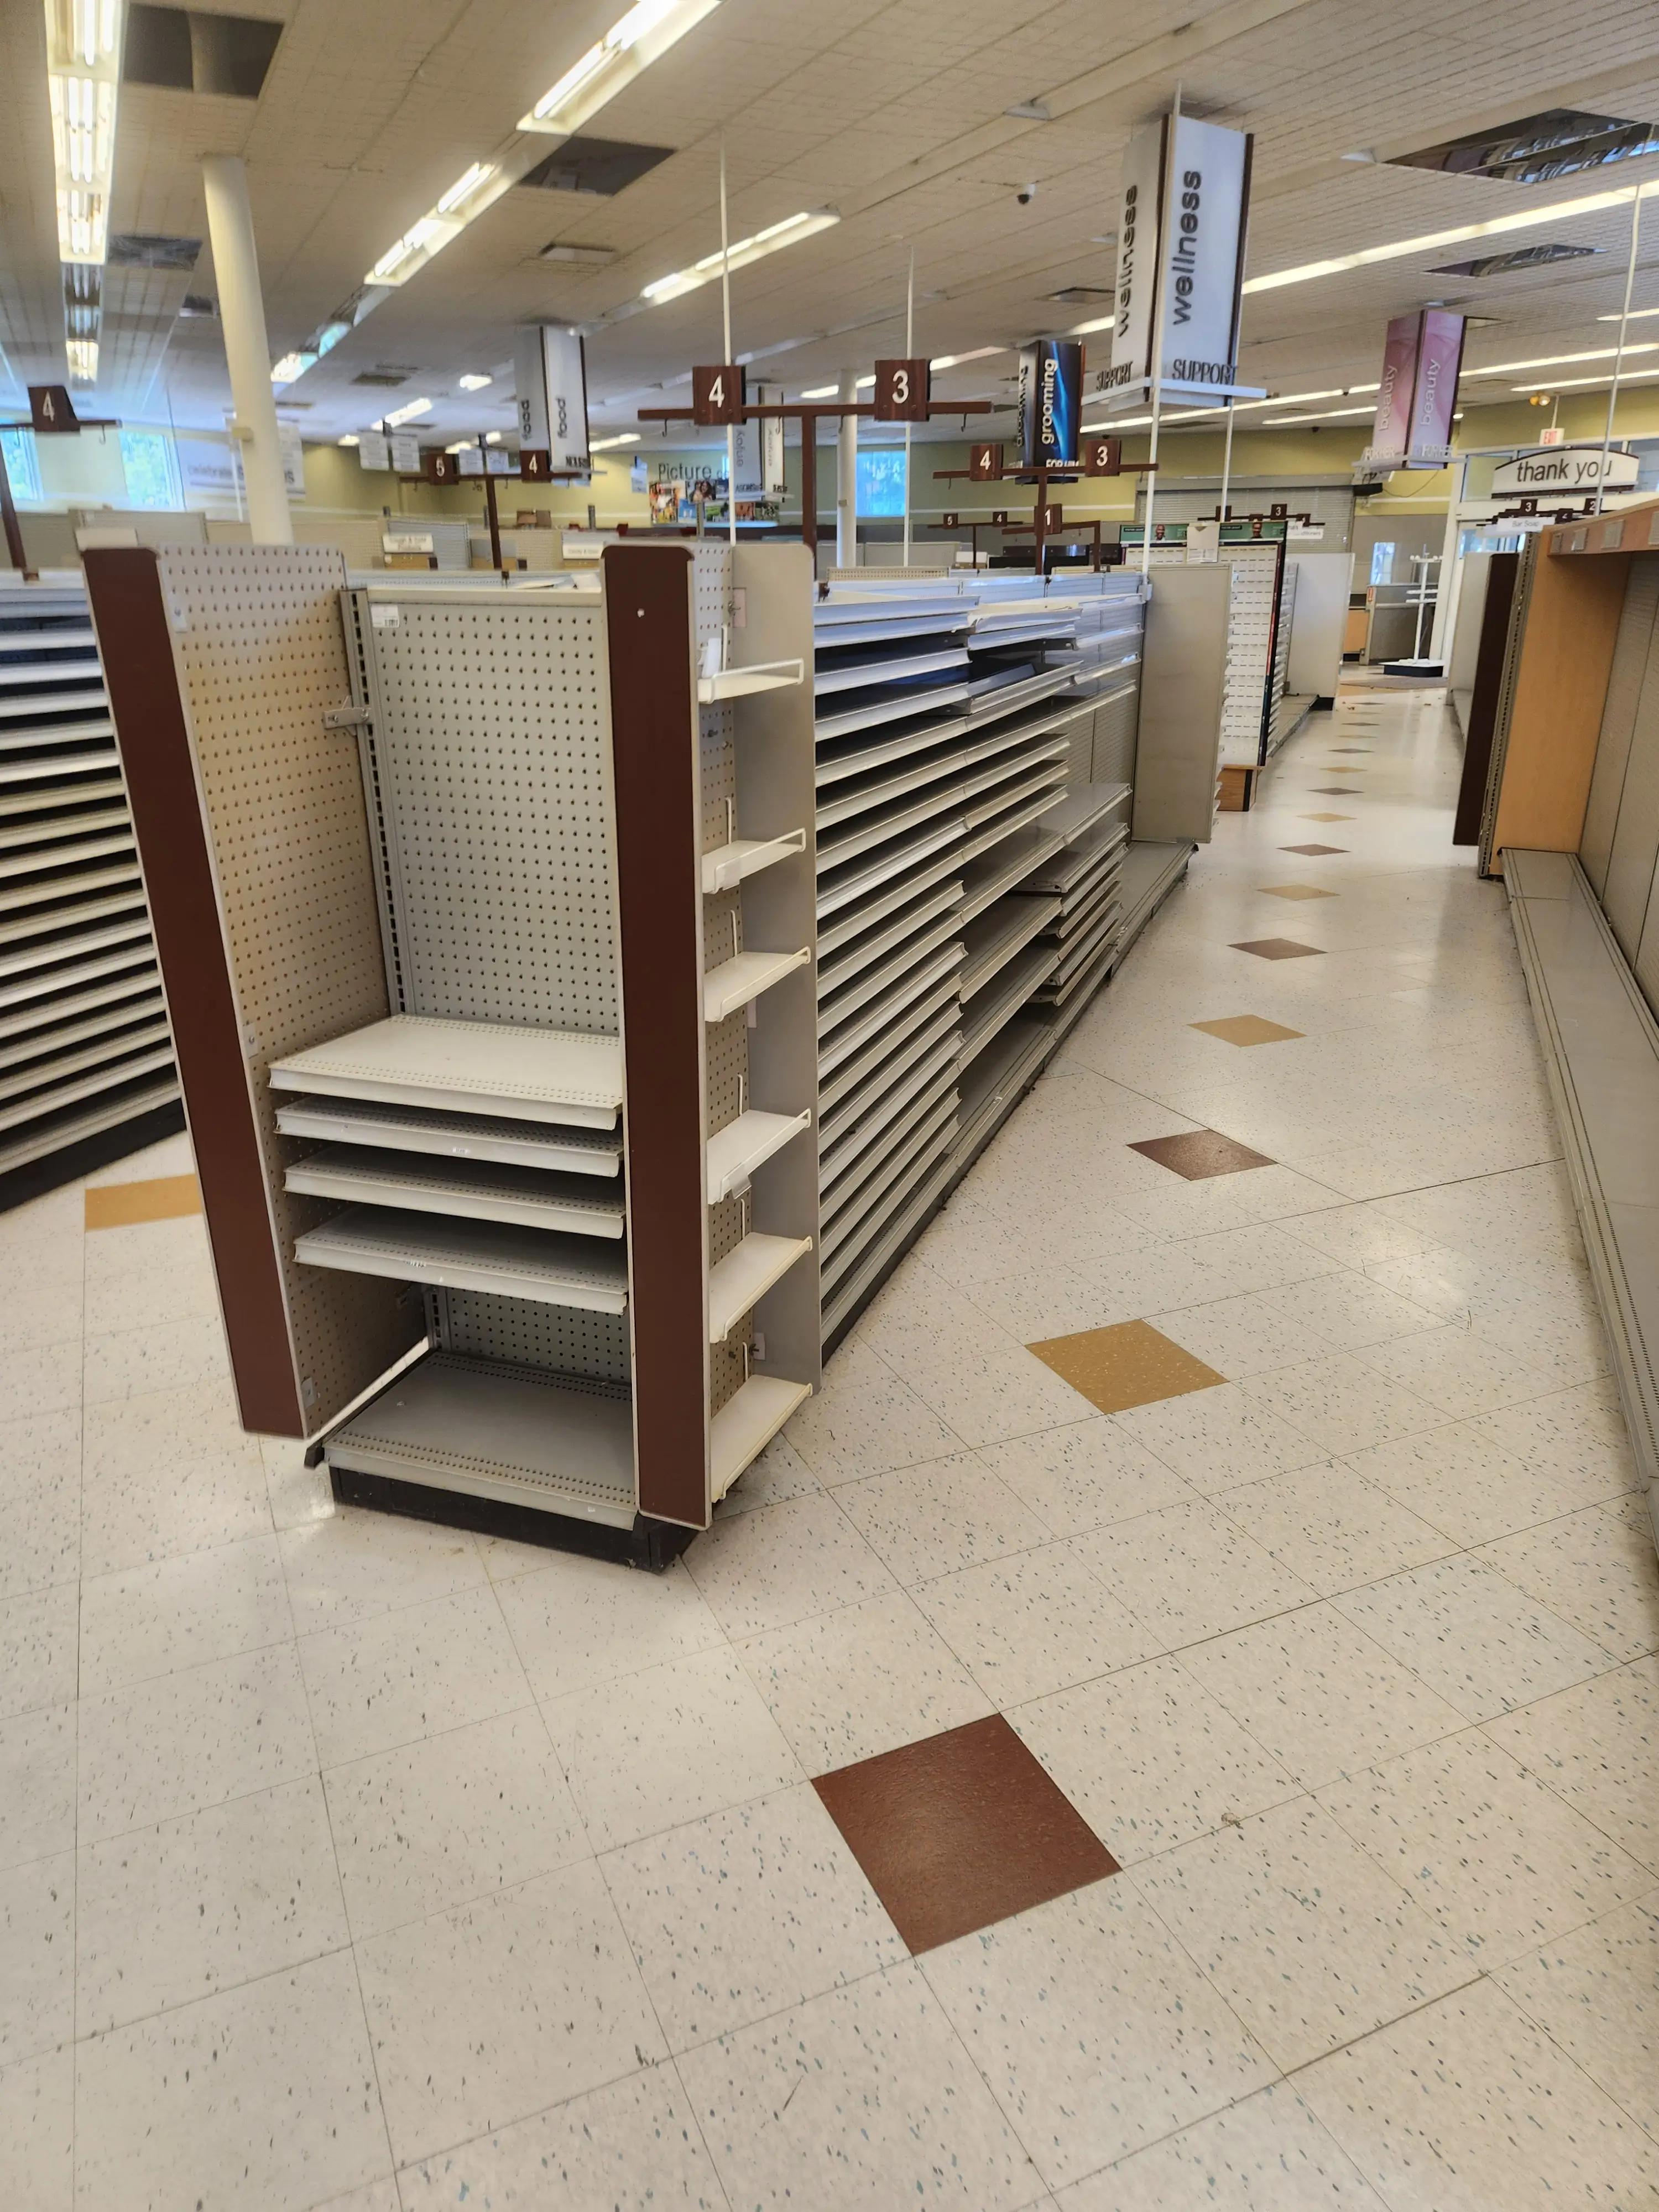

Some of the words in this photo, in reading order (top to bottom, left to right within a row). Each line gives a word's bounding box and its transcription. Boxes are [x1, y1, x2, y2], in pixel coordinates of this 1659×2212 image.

[1118, 185, 1138, 338] wellness
[1171, 170, 1202, 326] wellness
[1095, 361, 1133, 391] SUPPORT
[1172, 358, 1237, 385] SUPPORT
[708, 374, 725, 408] 4
[892, 369, 909, 404] 3
[1379, 364, 1398, 431] beauty
[1420, 358, 1441, 426] beauty
[43, 389, 55, 422] 4
[1041, 358, 1058, 445] grooming
[555, 396, 568, 439] food
[529, 453, 538, 473] 4
[979, 450, 992, 471] 4
[1095, 445, 1108, 467] 3
[1517, 458, 1570, 482] thank
[658, 462, 712, 481] Picture
[997, 514, 1003, 523] 4
[1045, 508, 1051, 526] 1
[1275, 507, 1281, 516] 3
[1525, 502, 1532, 513] 3
